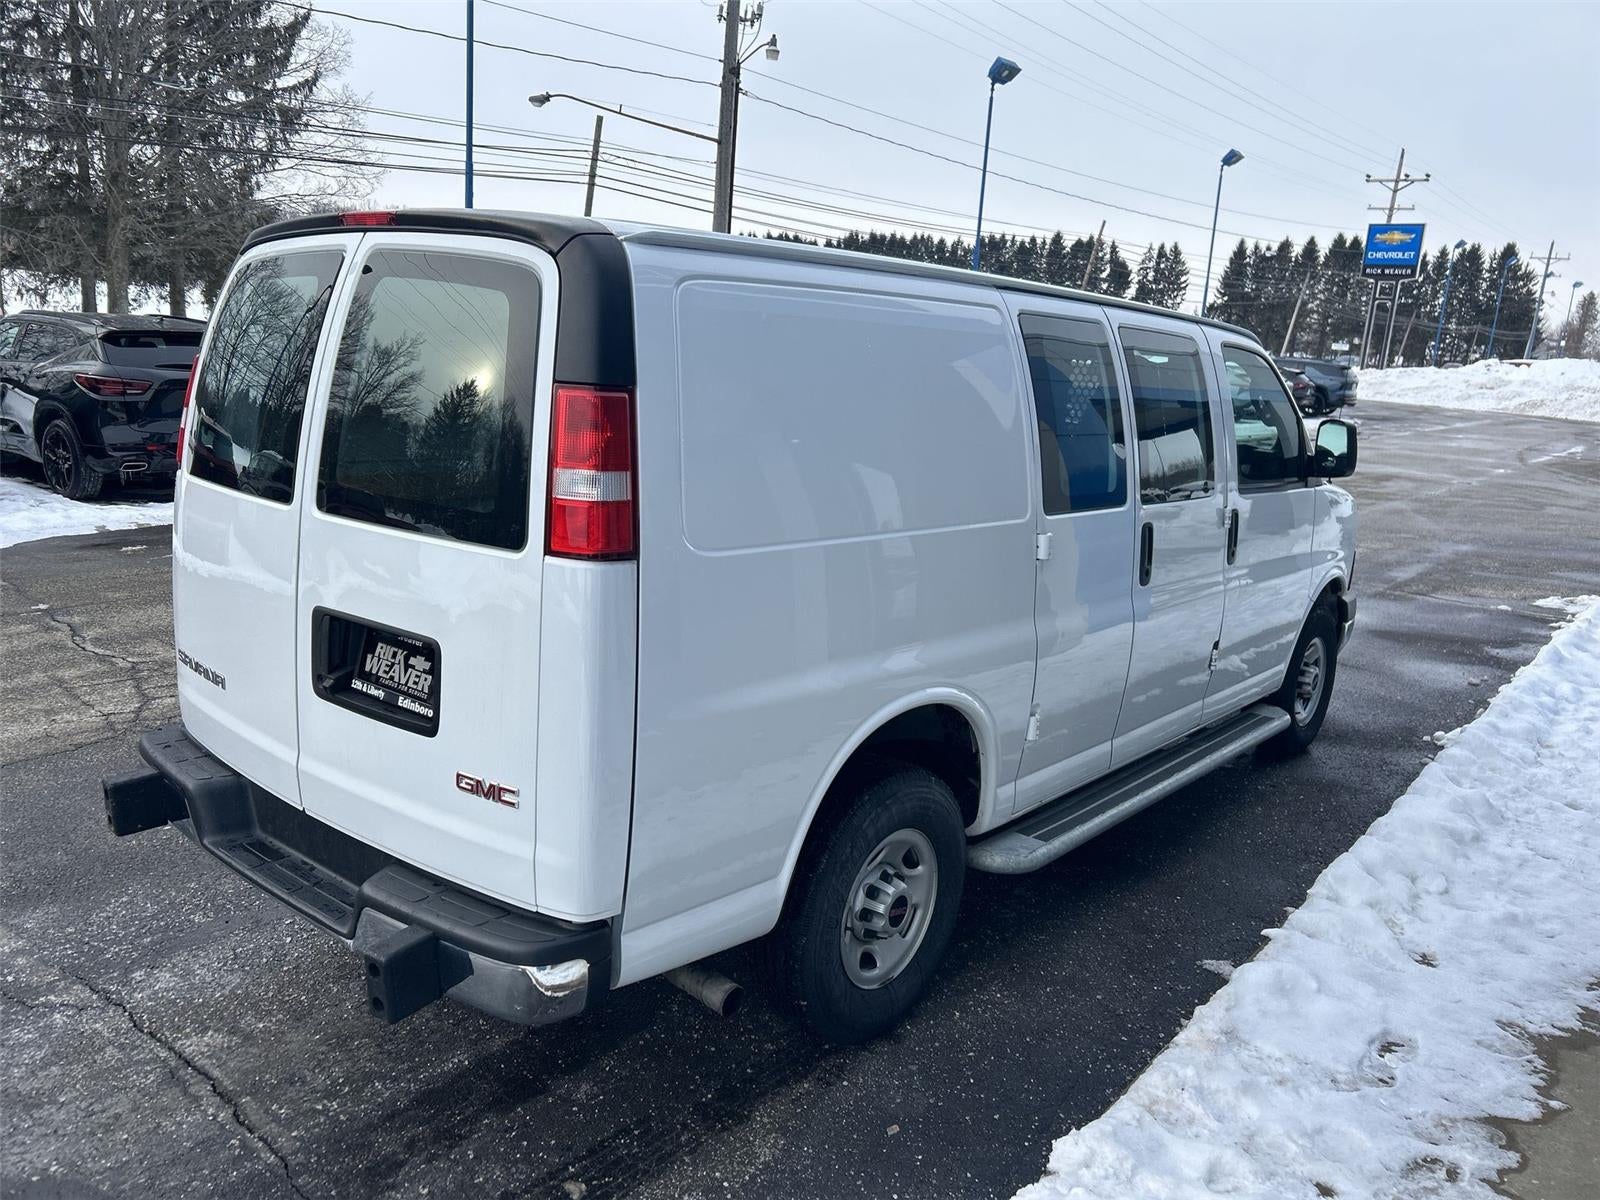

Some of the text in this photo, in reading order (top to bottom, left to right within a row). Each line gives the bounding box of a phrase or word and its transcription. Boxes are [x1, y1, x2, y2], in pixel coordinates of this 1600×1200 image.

[1367, 251, 1416, 259] CHEVROLET
[374, 641, 408, 665] RICK
[178, 648, 227, 691] SAVANA
[364, 653, 433, 694] WEAVER
[362, 683, 368, 692] &
[367, 684, 386, 701] Liberty
[397, 696, 434, 718] Edinboro
[455, 770, 520, 810] GMC
